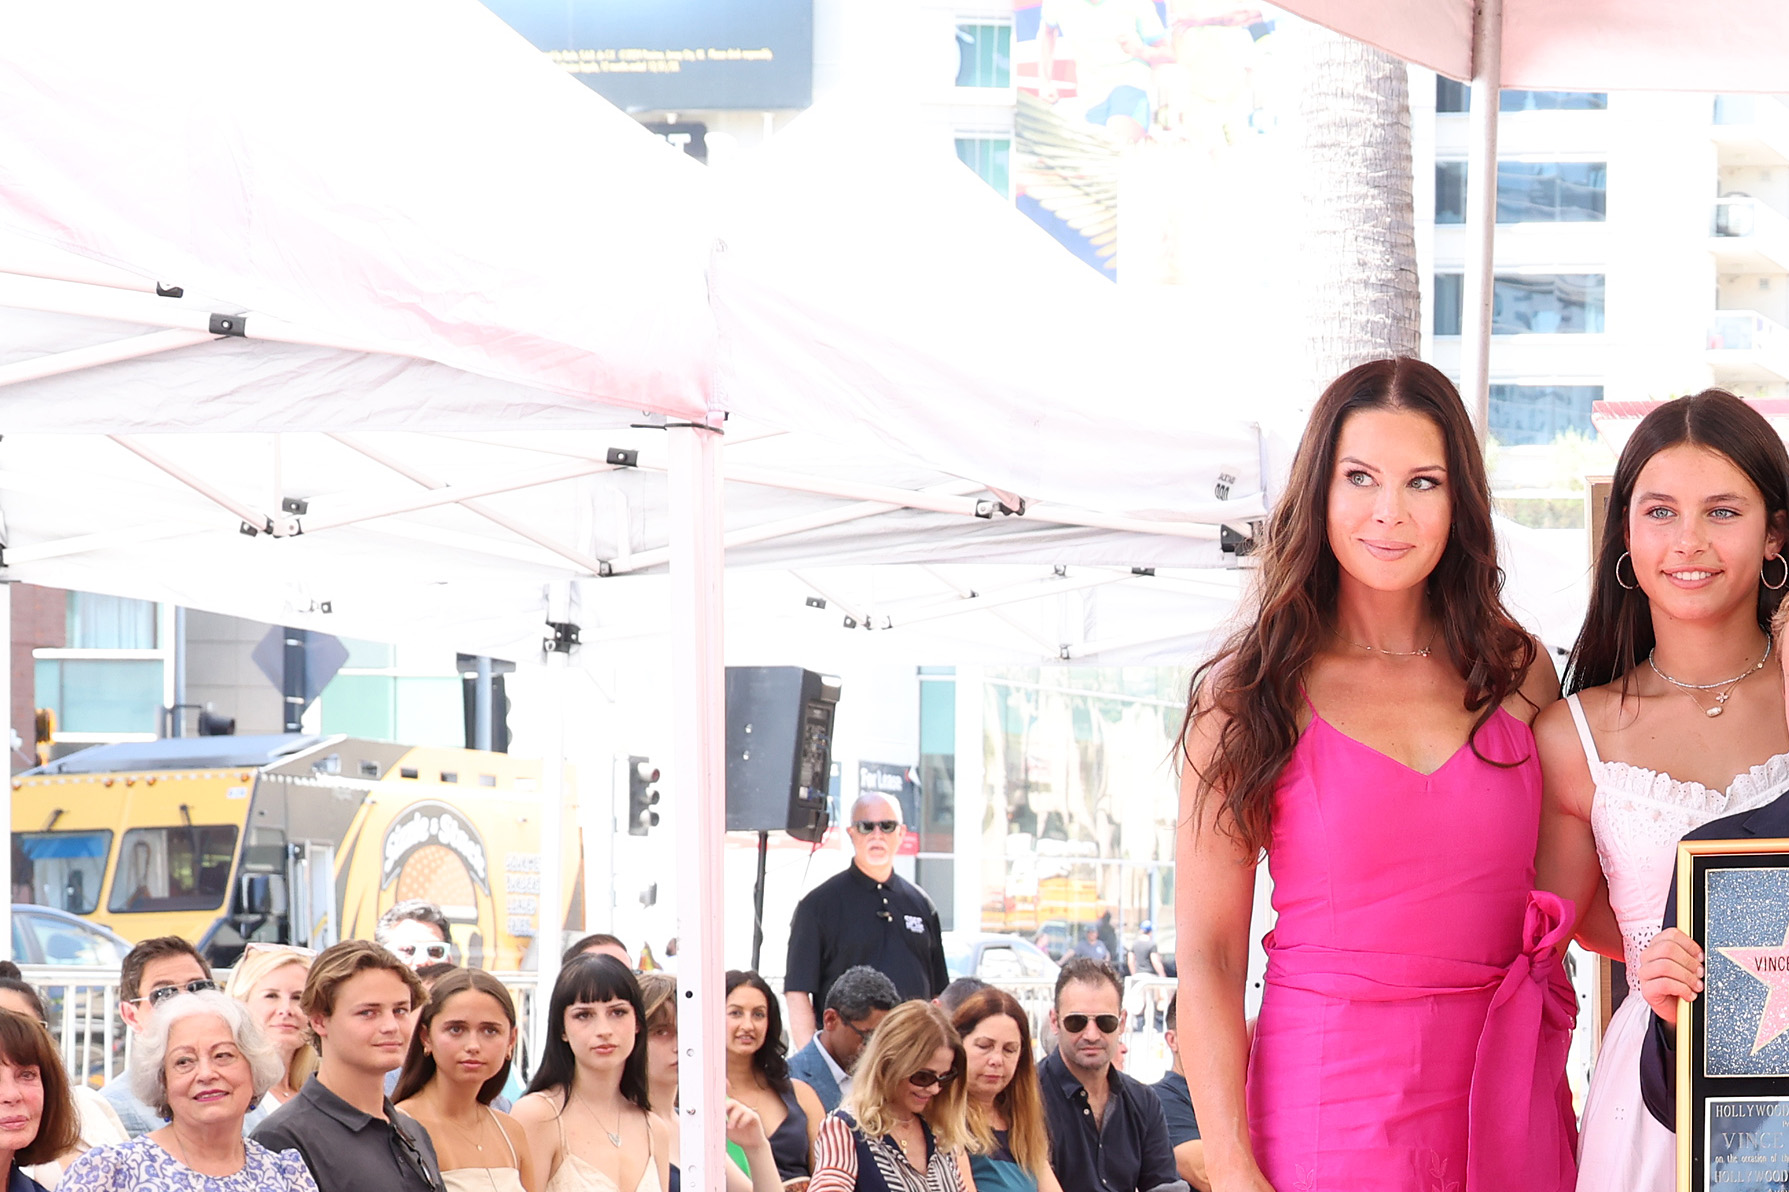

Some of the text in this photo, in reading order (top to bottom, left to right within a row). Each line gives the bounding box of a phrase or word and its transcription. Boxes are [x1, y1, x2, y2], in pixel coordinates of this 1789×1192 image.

[1715, 1103, 1789, 1118] HOLLYWOOD
[1721, 1132, 1785, 1149] VINCE
[1715, 1155, 1724, 1163] on
[1727, 1153, 1738, 1163] the
[1741, 1154, 1767, 1163] occasion
[1770, 1153, 1777, 1163] of
[1714, 1169, 1789, 1183] HOLLYWOOD
